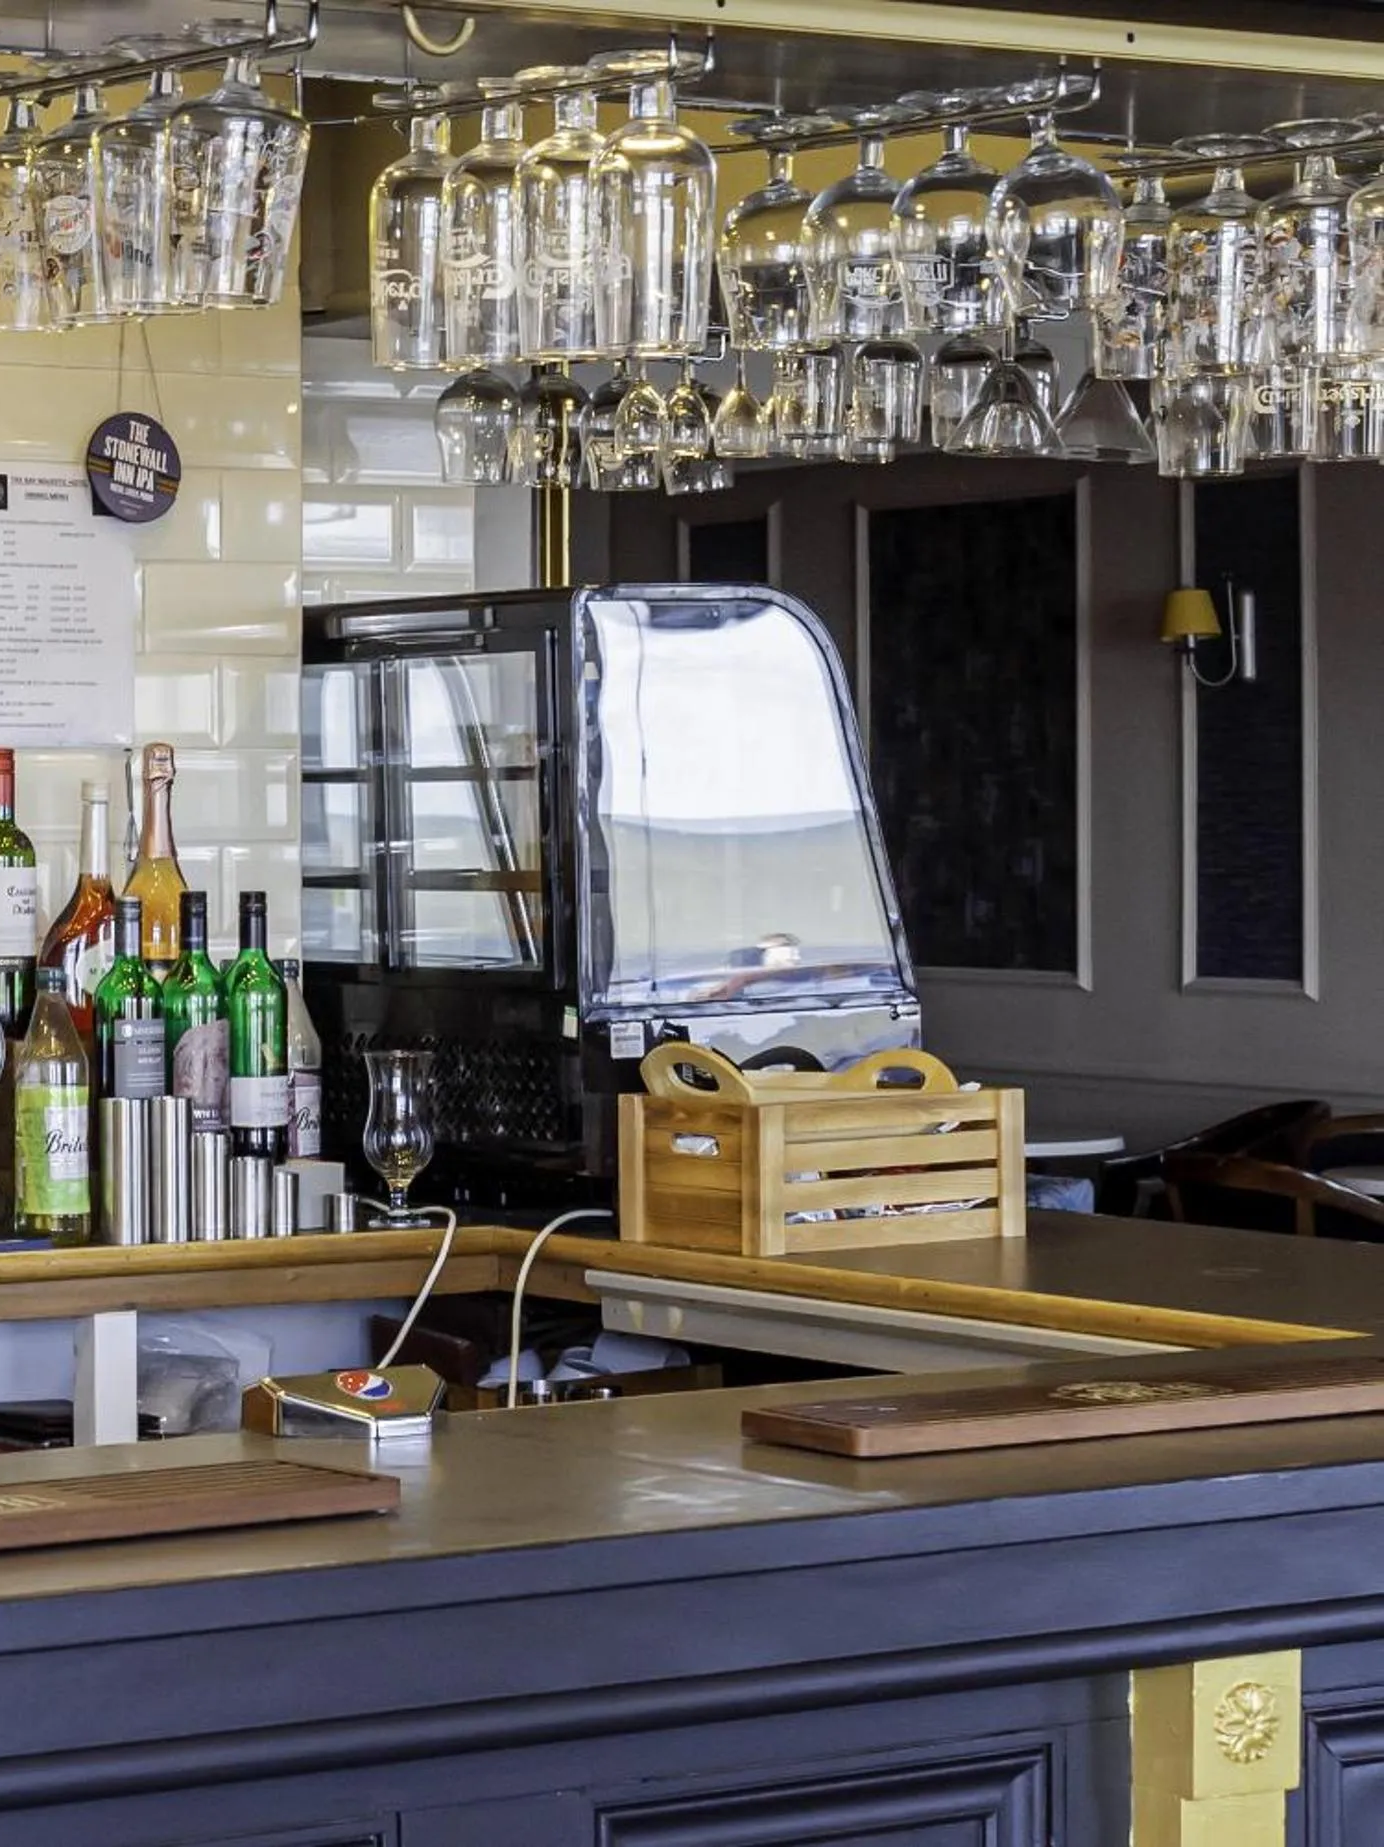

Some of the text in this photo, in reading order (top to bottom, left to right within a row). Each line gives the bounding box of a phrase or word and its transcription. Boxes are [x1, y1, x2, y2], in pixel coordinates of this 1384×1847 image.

[129, 420, 152, 446] THE
[103, 435, 169, 474] STONEWALL
[113, 460, 136, 486] INN
[136, 466, 155, 493] IPA
